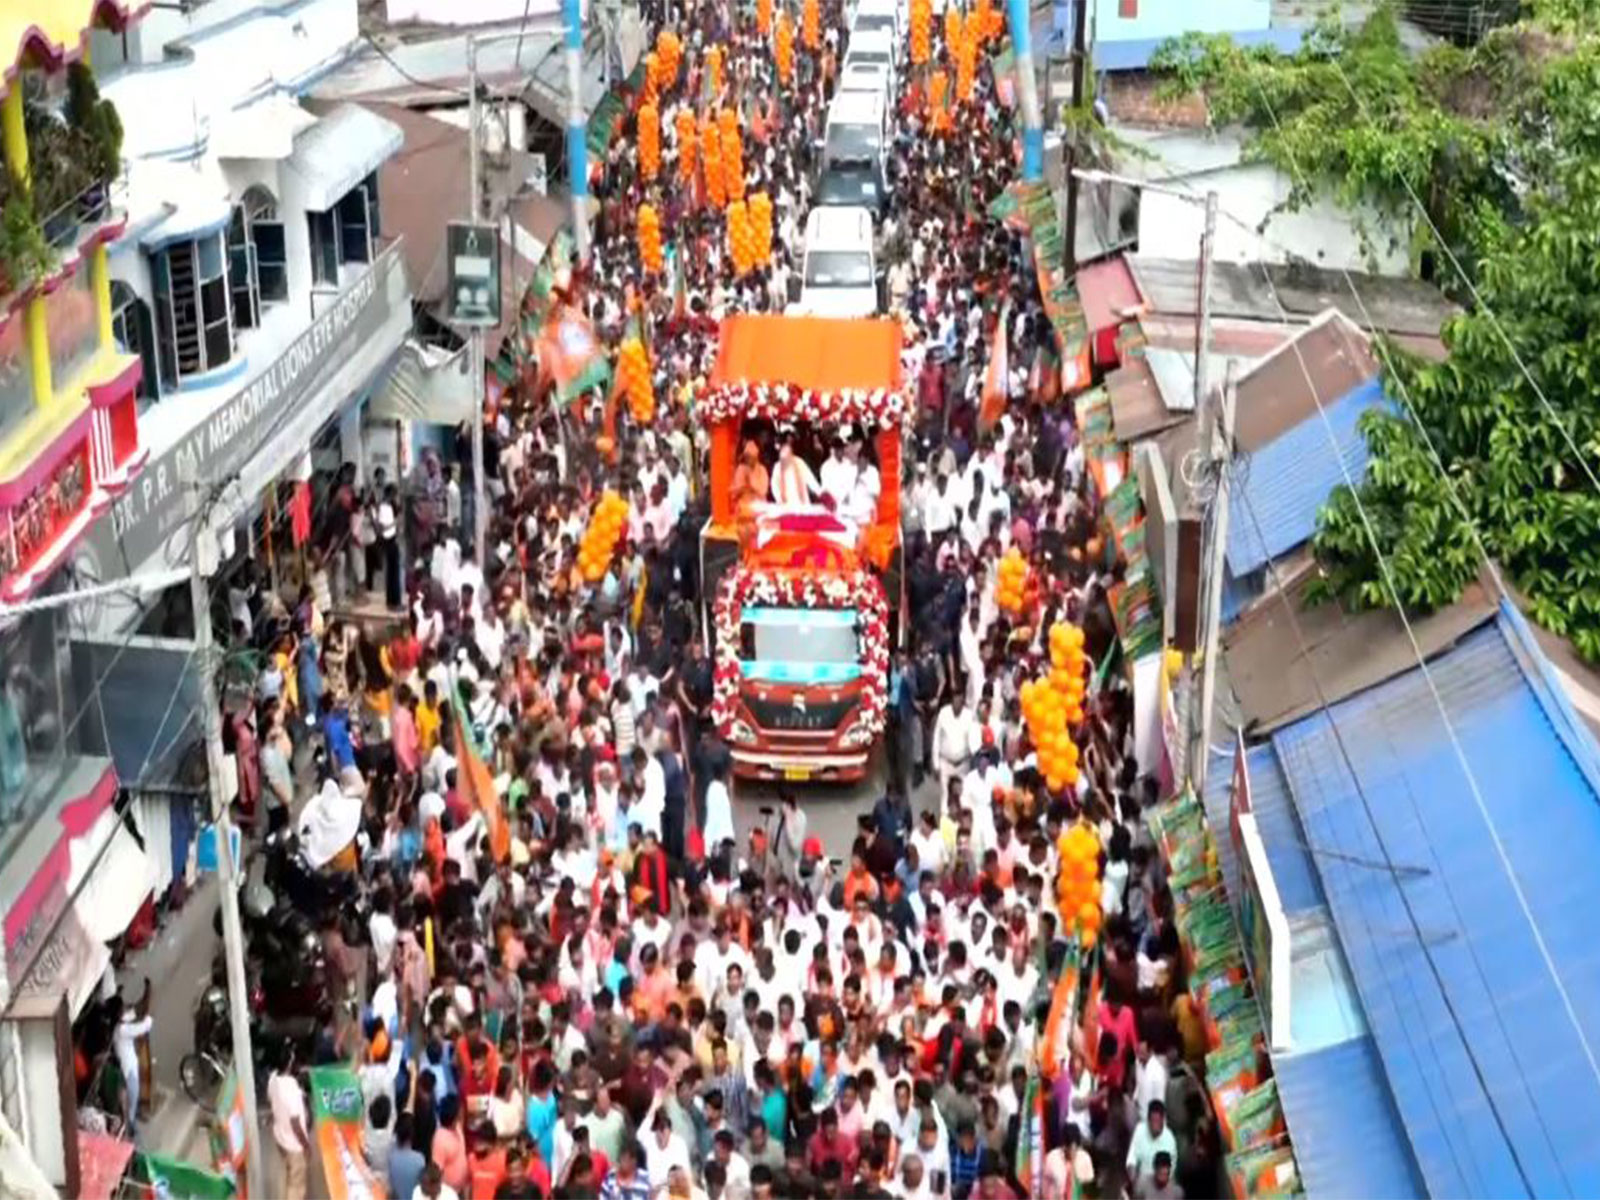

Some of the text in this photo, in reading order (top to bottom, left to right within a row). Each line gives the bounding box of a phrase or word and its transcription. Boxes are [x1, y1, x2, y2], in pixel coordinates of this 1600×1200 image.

[142, 464, 173, 514] P.R.
[209, 371, 280, 453] MEMORIAL
[279, 329, 314, 389] LIONS
[311, 316, 334, 355] EYE
